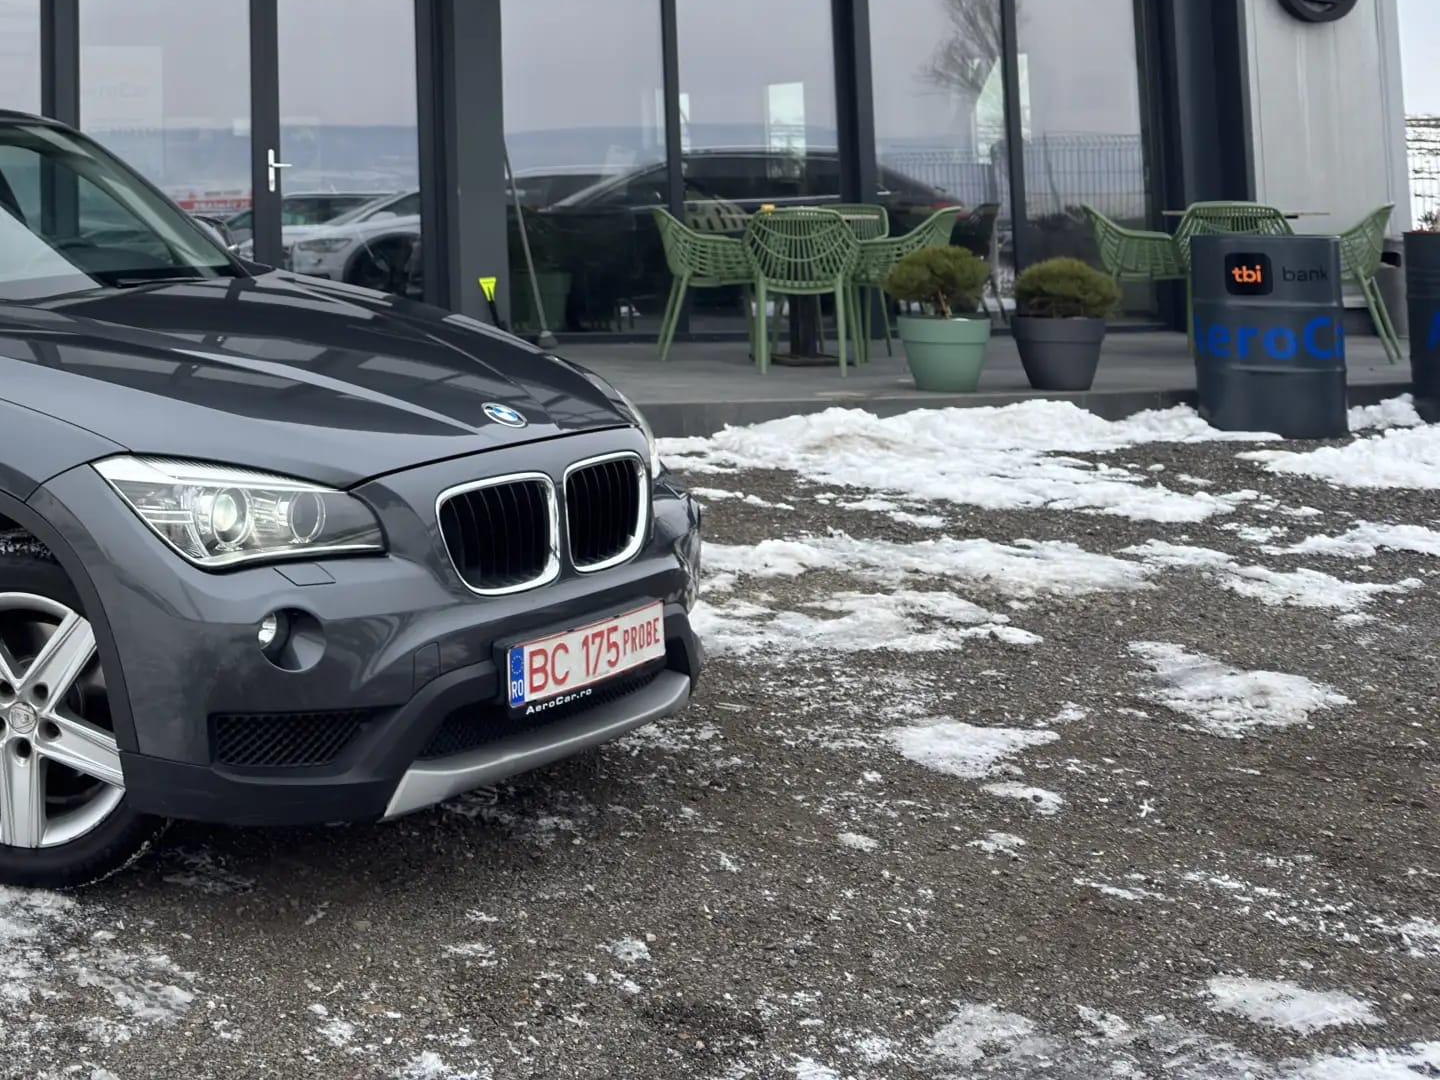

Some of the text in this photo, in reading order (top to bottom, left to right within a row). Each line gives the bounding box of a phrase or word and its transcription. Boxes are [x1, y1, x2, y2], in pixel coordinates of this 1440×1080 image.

[1231, 265, 1329, 284] tbi bank
[1193, 312, 1344, 361] eroC
[511, 617, 661, 698] RO BC 175 PROBE
[525, 687, 593, 715] AeroCar.ro
